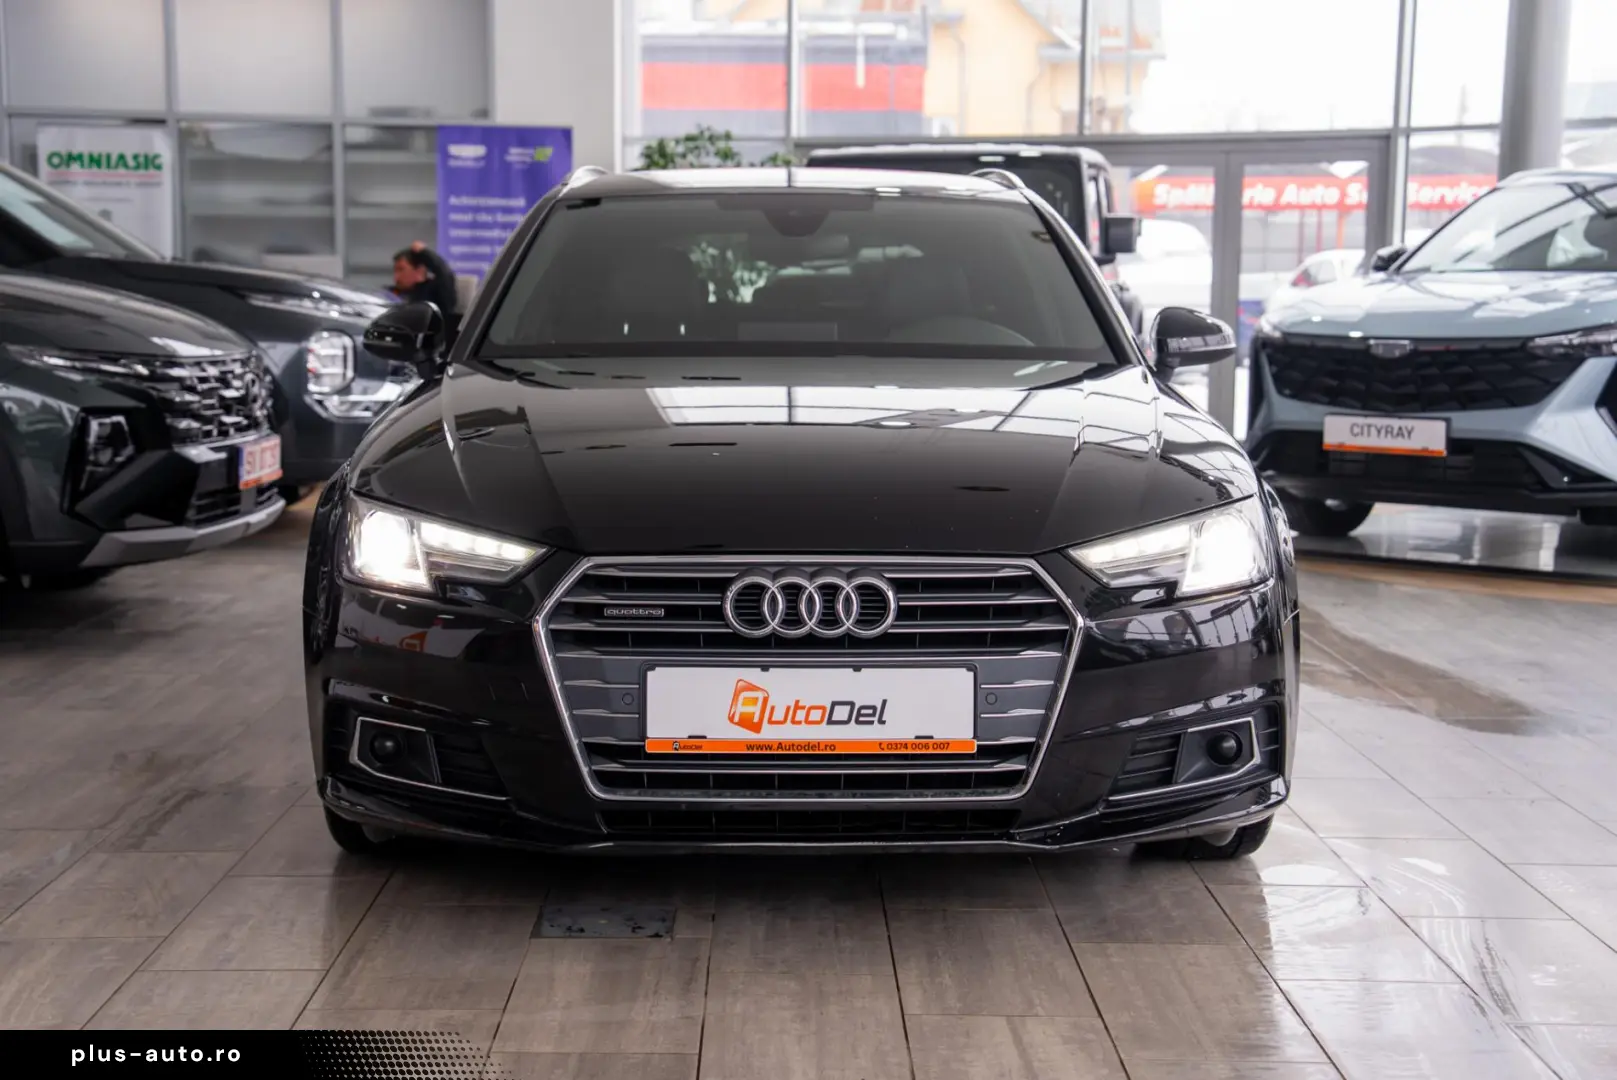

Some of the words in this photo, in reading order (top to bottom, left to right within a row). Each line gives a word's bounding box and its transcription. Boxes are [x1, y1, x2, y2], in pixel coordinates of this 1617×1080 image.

[46, 151, 164, 171] OMNIASIG
[1279, 183, 1341, 206] Auto
[1349, 422, 1415, 440] CITYRAY
[605, 607, 663, 617] quattro
[731, 686, 888, 728] AutoDel
[745, 742, 837, 752] www.Autodel.ro
[886, 742, 909, 751] 0374
[910, 742, 930, 751] 006
[931, 742, 951, 751] 007
